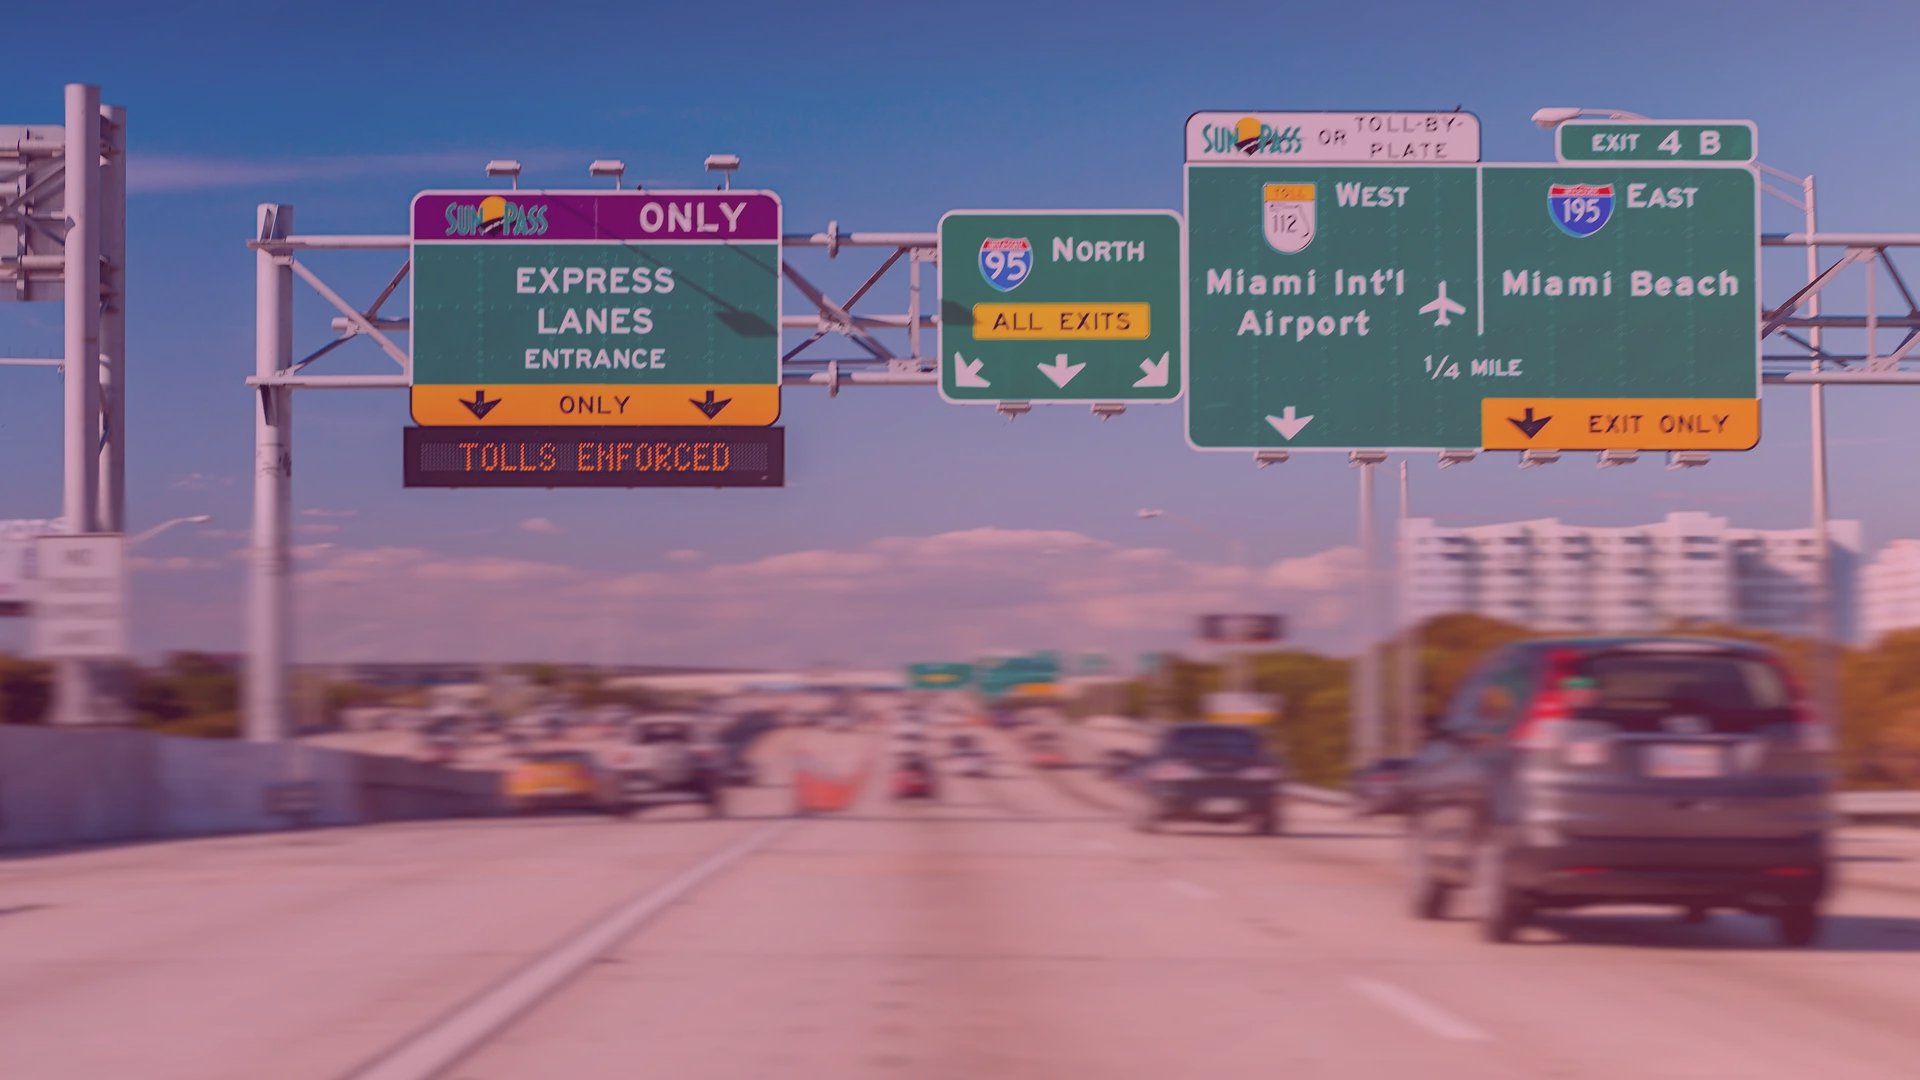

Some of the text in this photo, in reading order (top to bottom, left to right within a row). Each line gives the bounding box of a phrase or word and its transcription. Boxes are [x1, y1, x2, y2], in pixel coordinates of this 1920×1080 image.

[1318, 128, 1348, 146] OR
[1591, 130, 1722, 156] EXIT 4 B
[1370, 142, 1448, 159] PLATE
[639, 201, 748, 234] ONLY
[1272, 214, 1298, 234] 112
[1563, 198, 1600, 224] 195
[985, 251, 1027, 281] 95
[516, 267, 675, 294] EXPRESS
[1206, 268, 1405, 296] Miami Int'l
[1502, 269, 1739, 297] Miami Beach
[537, 307, 654, 335] LANES
[992, 312, 1132, 331] ALL EXITS
[1237, 309, 1371, 342] Airport
[525, 348, 667, 370] ENTRANCE
[1423, 354, 1524, 381] 1/4 MILE
[559, 395, 631, 415] ONLY
[1588, 414, 1730, 435] EXIT ONLY
[459, 442, 730, 472] TOLLS ENFORCED
